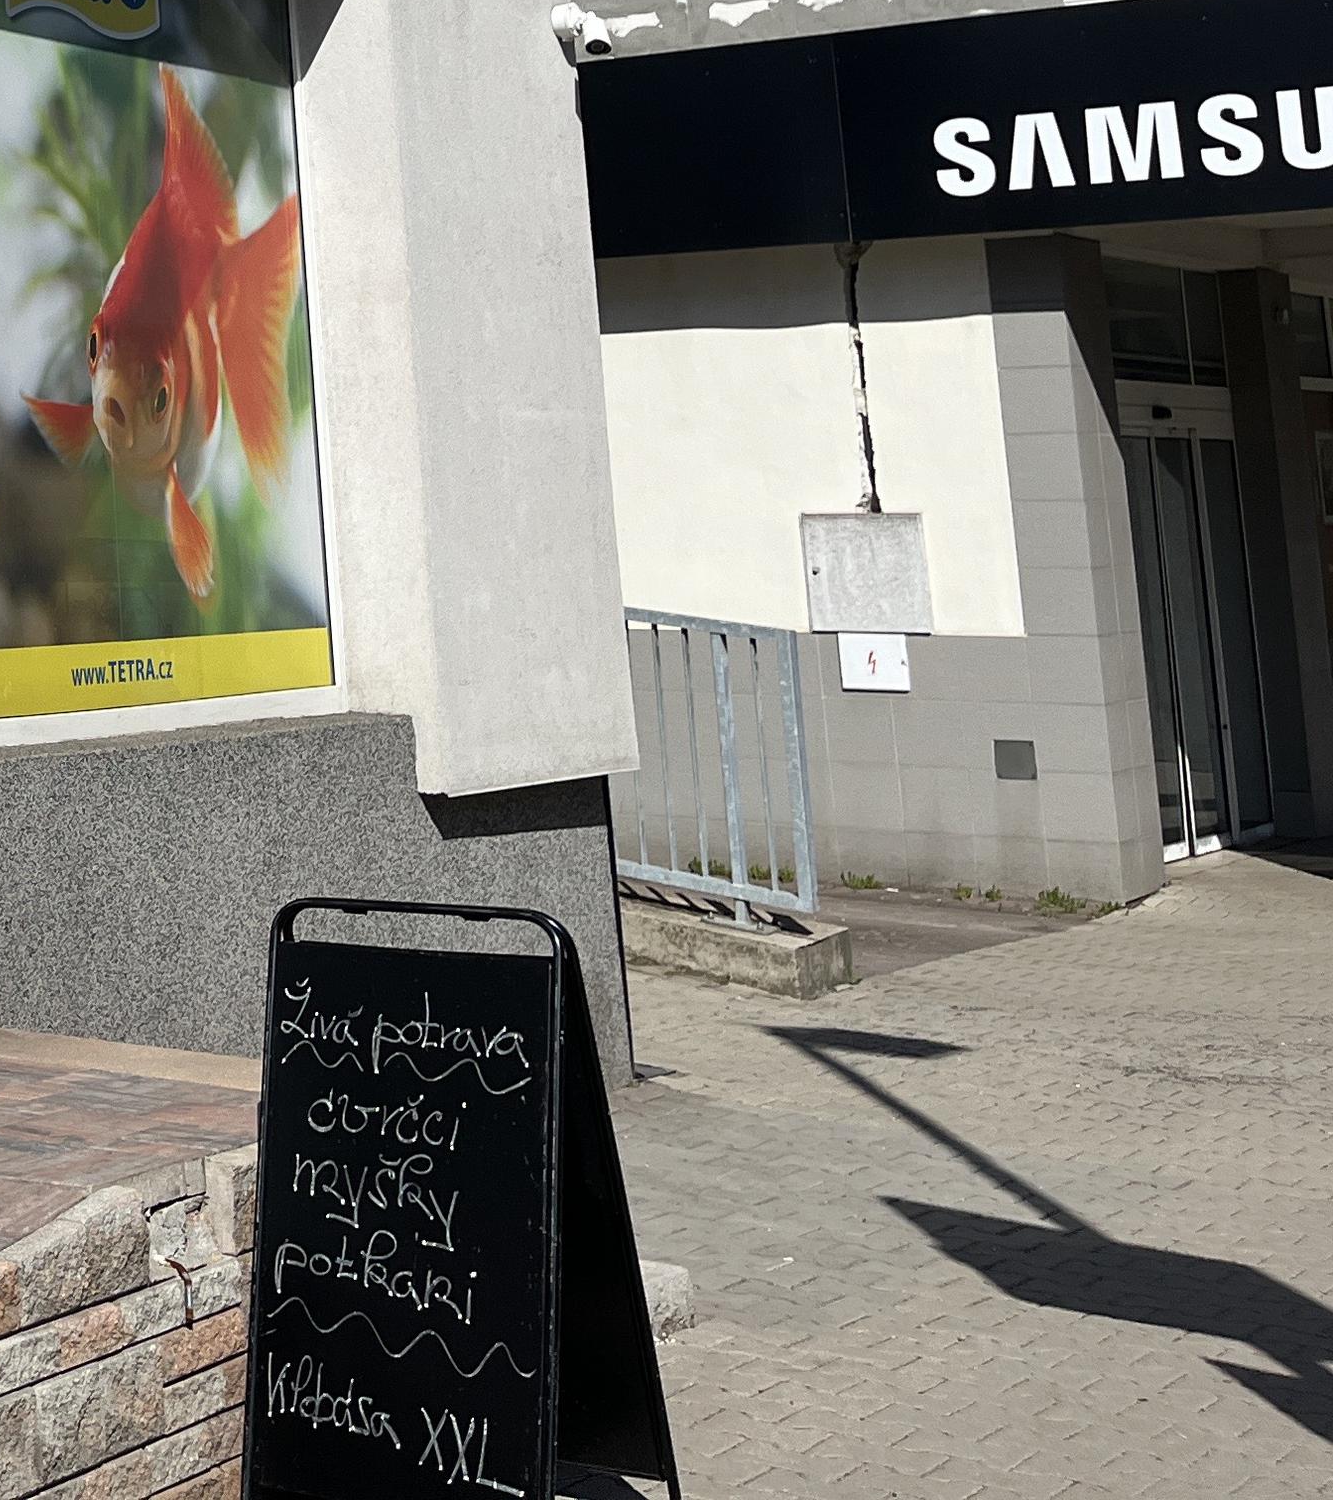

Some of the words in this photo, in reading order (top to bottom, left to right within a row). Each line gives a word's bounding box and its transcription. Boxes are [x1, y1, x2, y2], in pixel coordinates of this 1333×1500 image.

[933, 85, 1333, 198] SAMSU
[371, 991, 530, 1075] potrava
[293, 1153, 460, 1252] myšky
[418, 1406, 526, 1498] XXL
